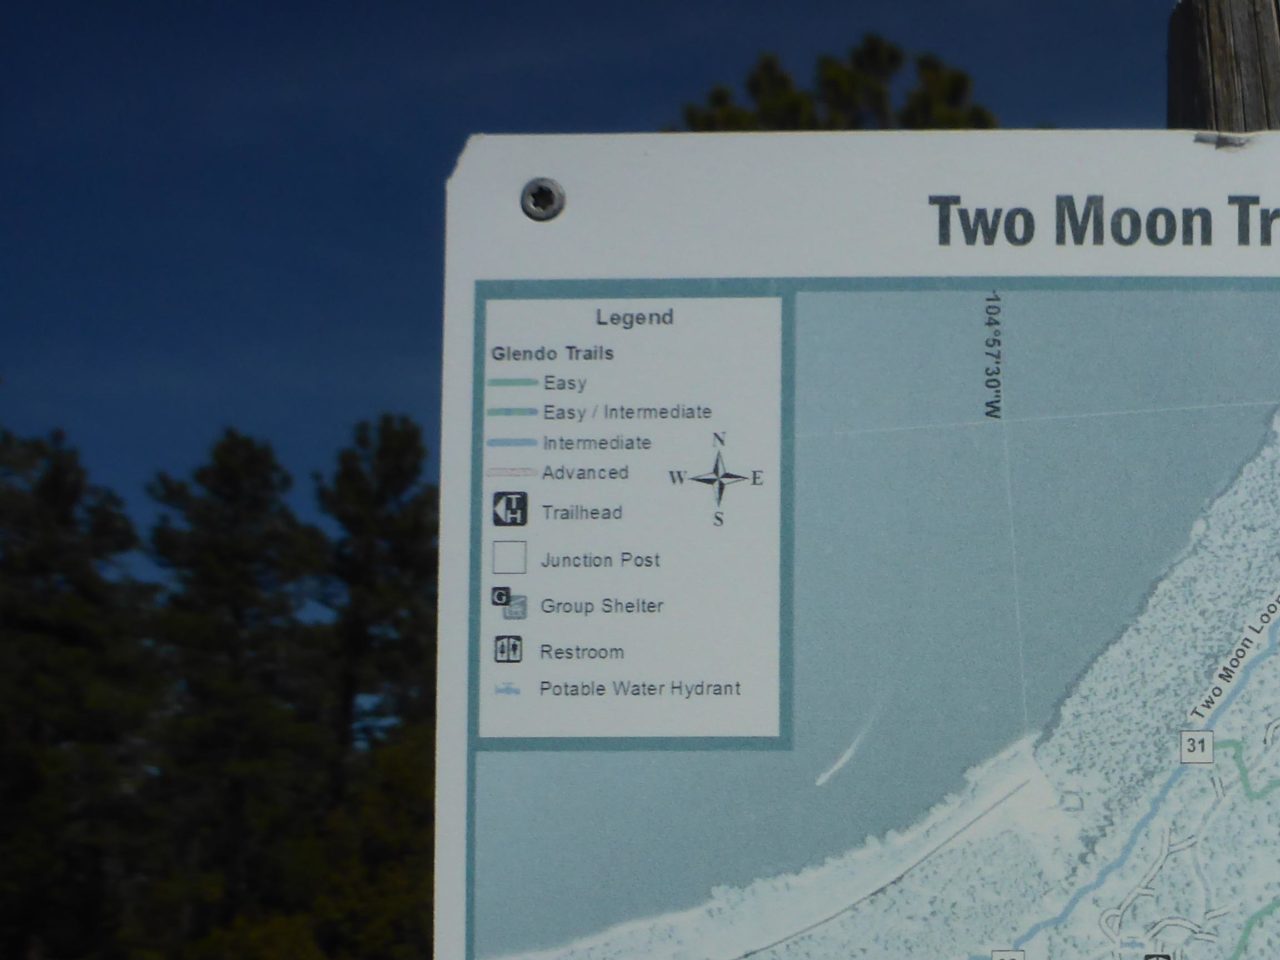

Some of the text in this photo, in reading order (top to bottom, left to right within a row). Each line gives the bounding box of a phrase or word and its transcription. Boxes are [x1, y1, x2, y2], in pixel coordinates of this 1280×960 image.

[928, 195, 1035, 247] Two
[1055, 195, 1212, 247] Moon
[596, 308, 674, 329] Legend
[491, 346, 615, 361] Glendo Trails
[544, 375, 588, 394] Easy
[543, 404, 588, 424] Easy
[604, 404, 712, 420] Intermediate
[543, 435, 652, 450] Intermediate
[712, 432, 727, 448] N
[542, 465, 629, 480] Advanced
[669, 471, 688, 486] W
[751, 471, 763, 486] E
[542, 504, 623, 521] Trailhead
[714, 511, 724, 527] S
[541, 552, 660, 569] Junction Post
[541, 597, 663, 616] Group Shelter
[541, 645, 625, 660] Restroom
[1191, 684, 1223, 721] Two
[1219, 635, 1254, 685] Moon
[540, 680, 741, 699] Potable Water Hydrant
[1187, 737, 1206, 753] 31
